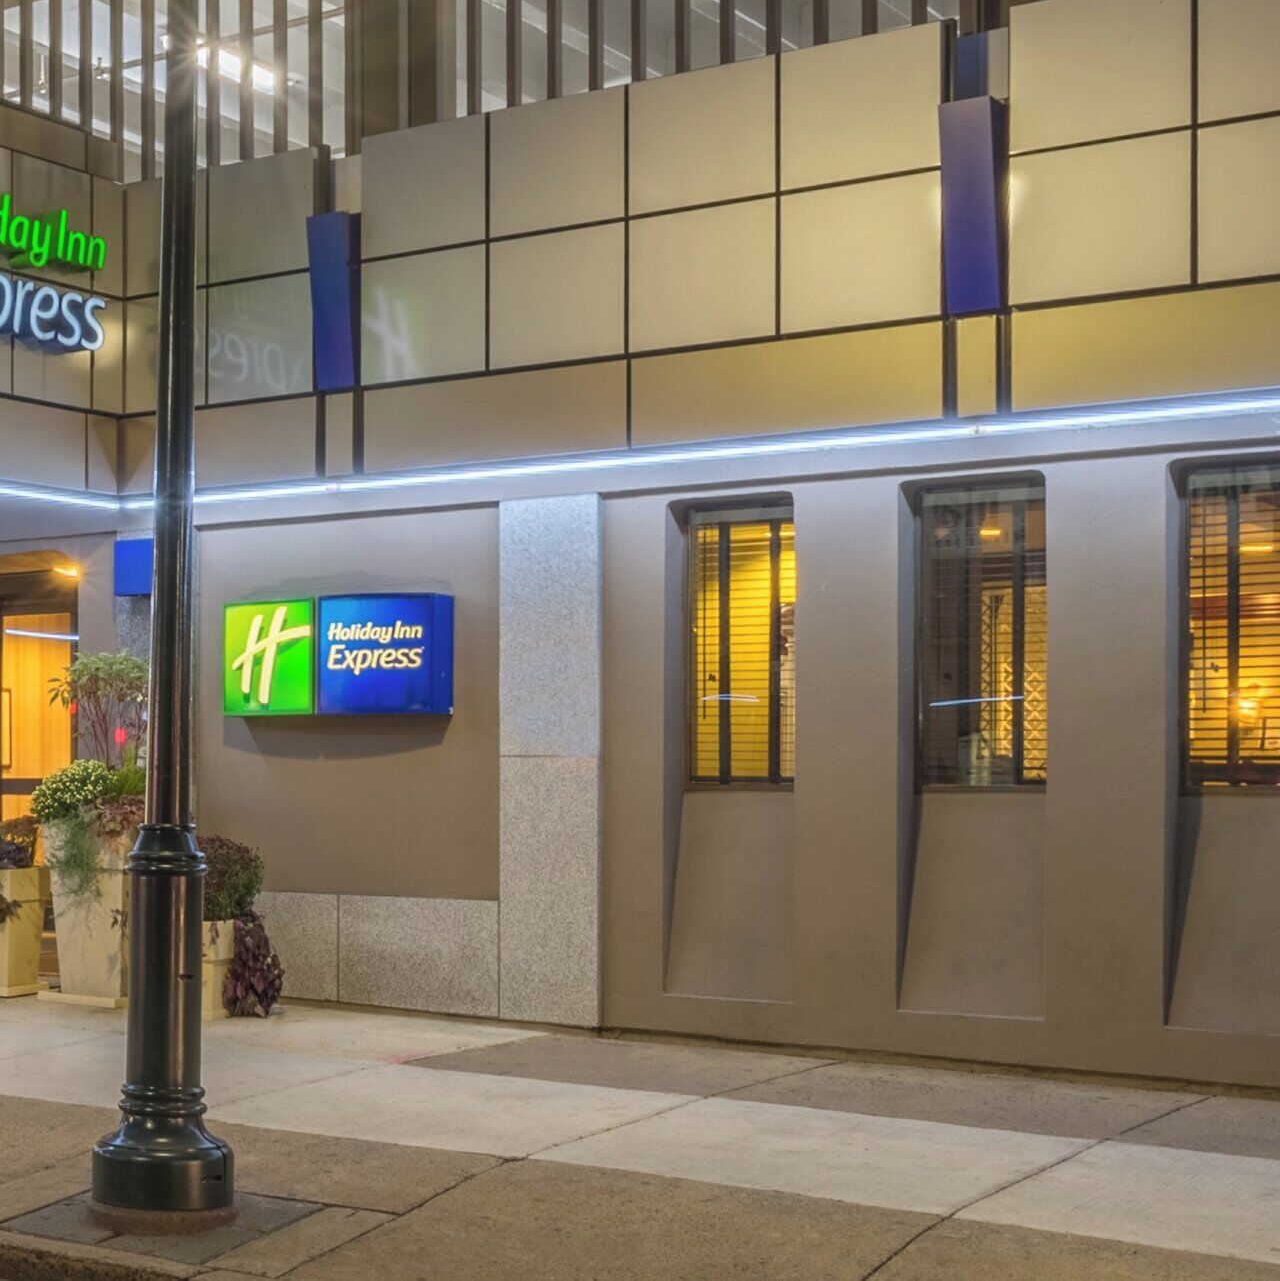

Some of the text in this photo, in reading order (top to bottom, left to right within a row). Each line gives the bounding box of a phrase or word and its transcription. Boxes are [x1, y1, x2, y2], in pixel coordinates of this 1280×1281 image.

[56, 208, 107, 270] Inn
[327, 620, 424, 644] Holiday Inn
[326, 644, 425, 676] Express
